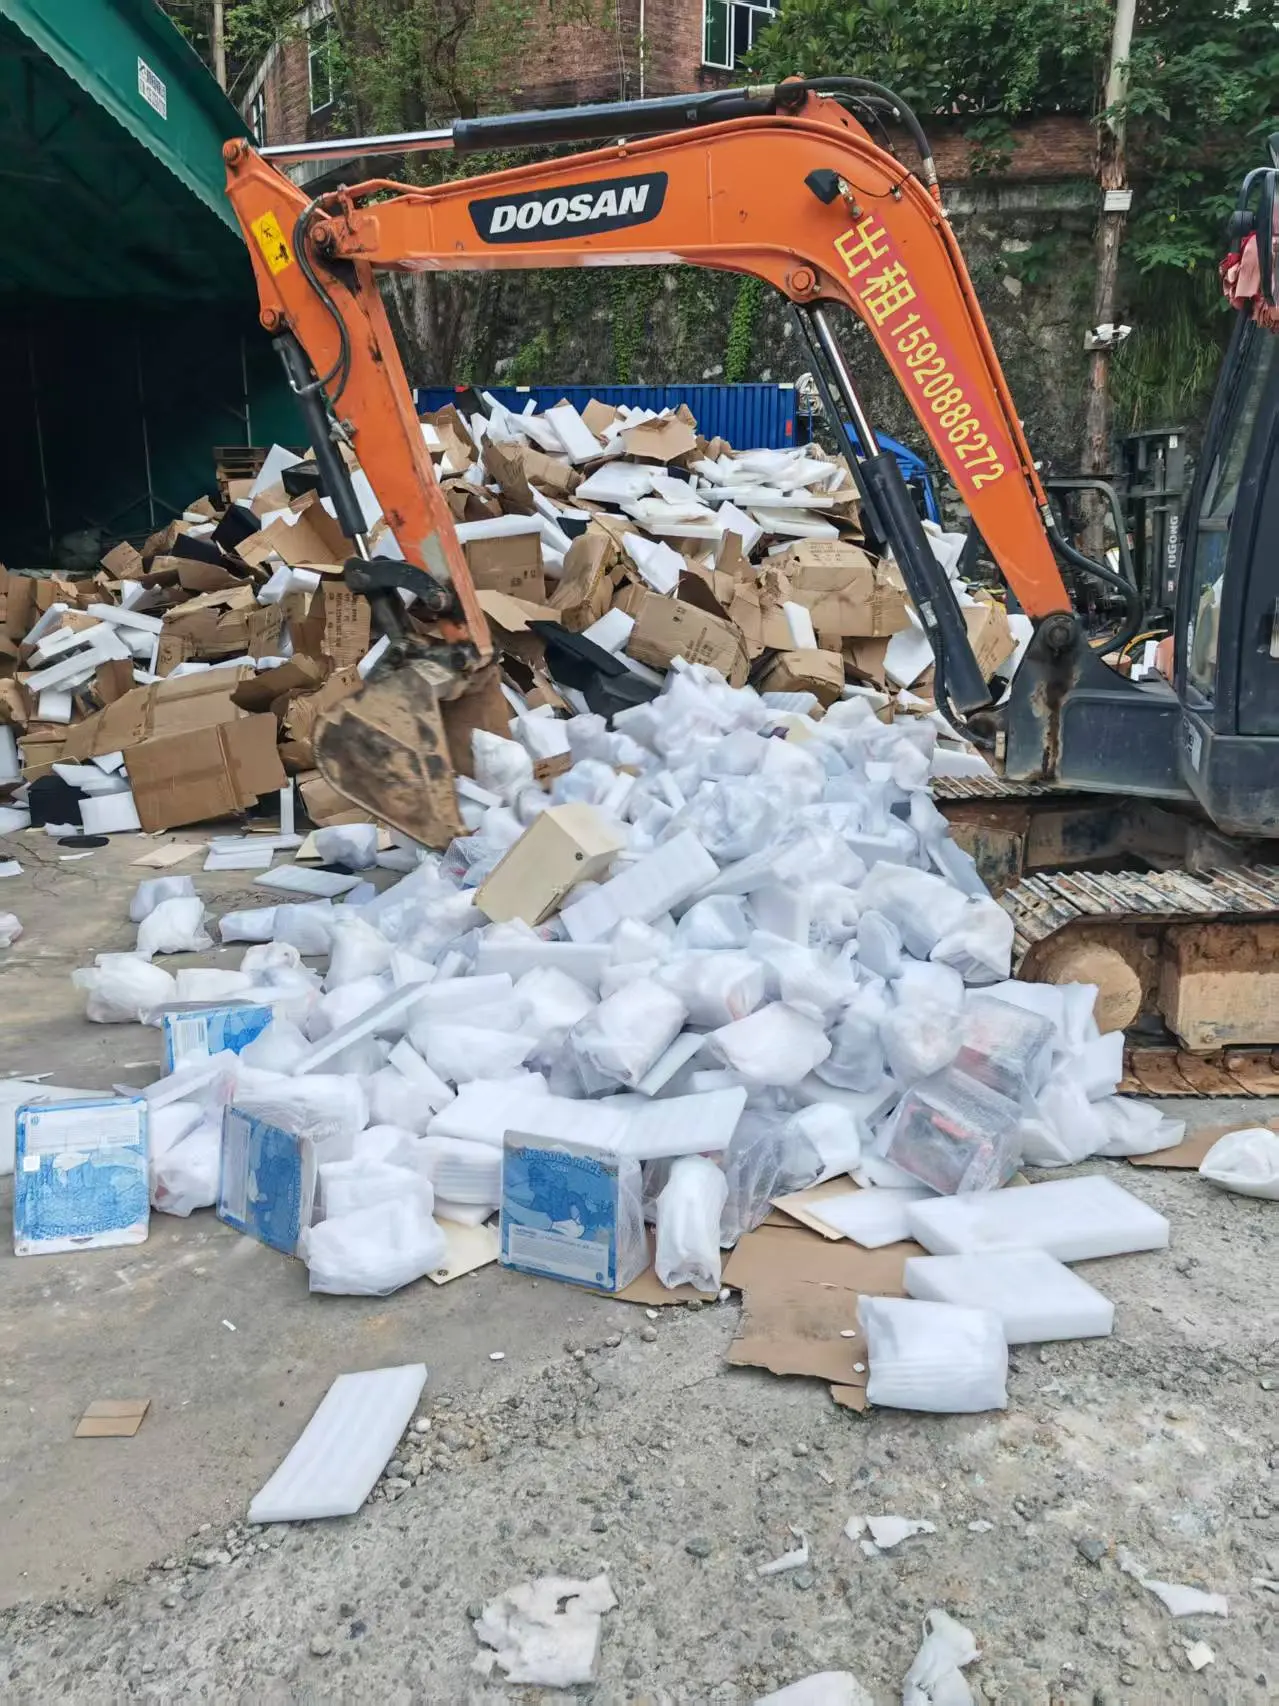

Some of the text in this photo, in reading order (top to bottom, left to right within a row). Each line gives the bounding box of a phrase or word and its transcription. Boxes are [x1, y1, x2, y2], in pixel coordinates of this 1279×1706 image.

[489, 184, 650, 234] DOOSAN
[833, 215, 1005, 489] 出租 15920886272
